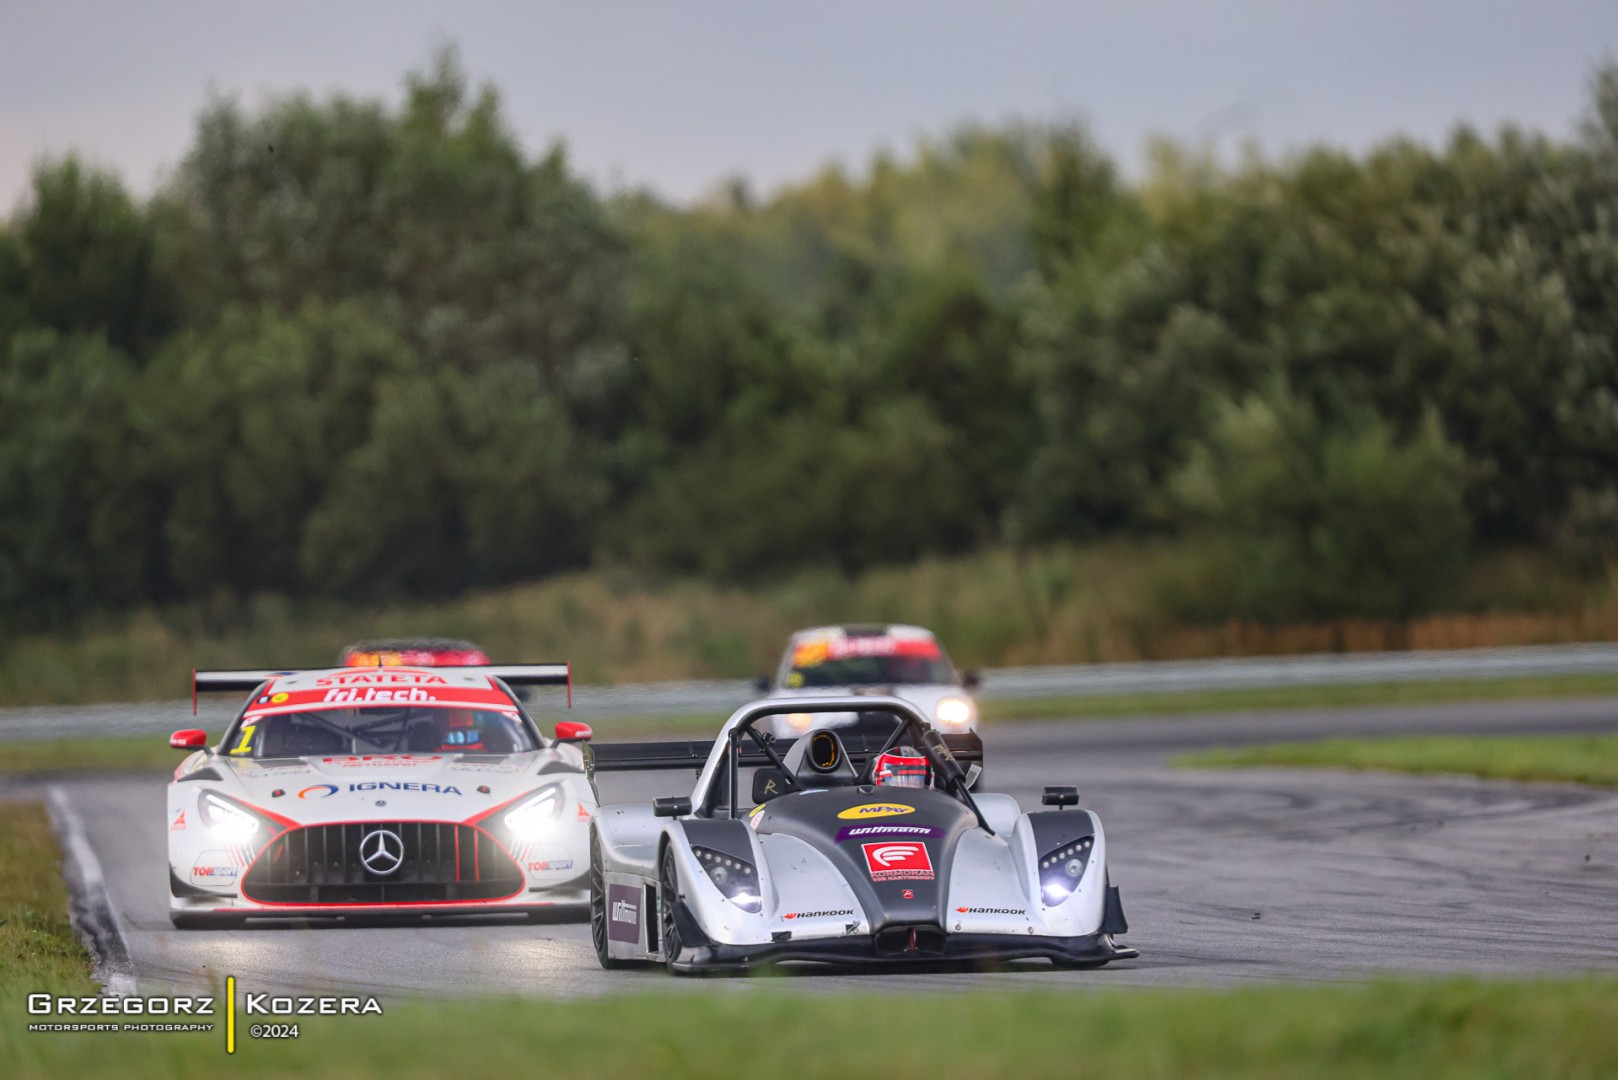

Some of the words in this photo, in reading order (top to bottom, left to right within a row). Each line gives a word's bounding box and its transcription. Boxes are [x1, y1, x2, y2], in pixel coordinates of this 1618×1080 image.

[317, 675, 447, 686] STATETA
[230, 725, 256, 755] 1
[349, 781, 463, 796] IGNERA
[764, 779, 779, 794] R
[796, 909, 854, 919] HANKOOK
[968, 906, 1027, 916] HANKOOK
